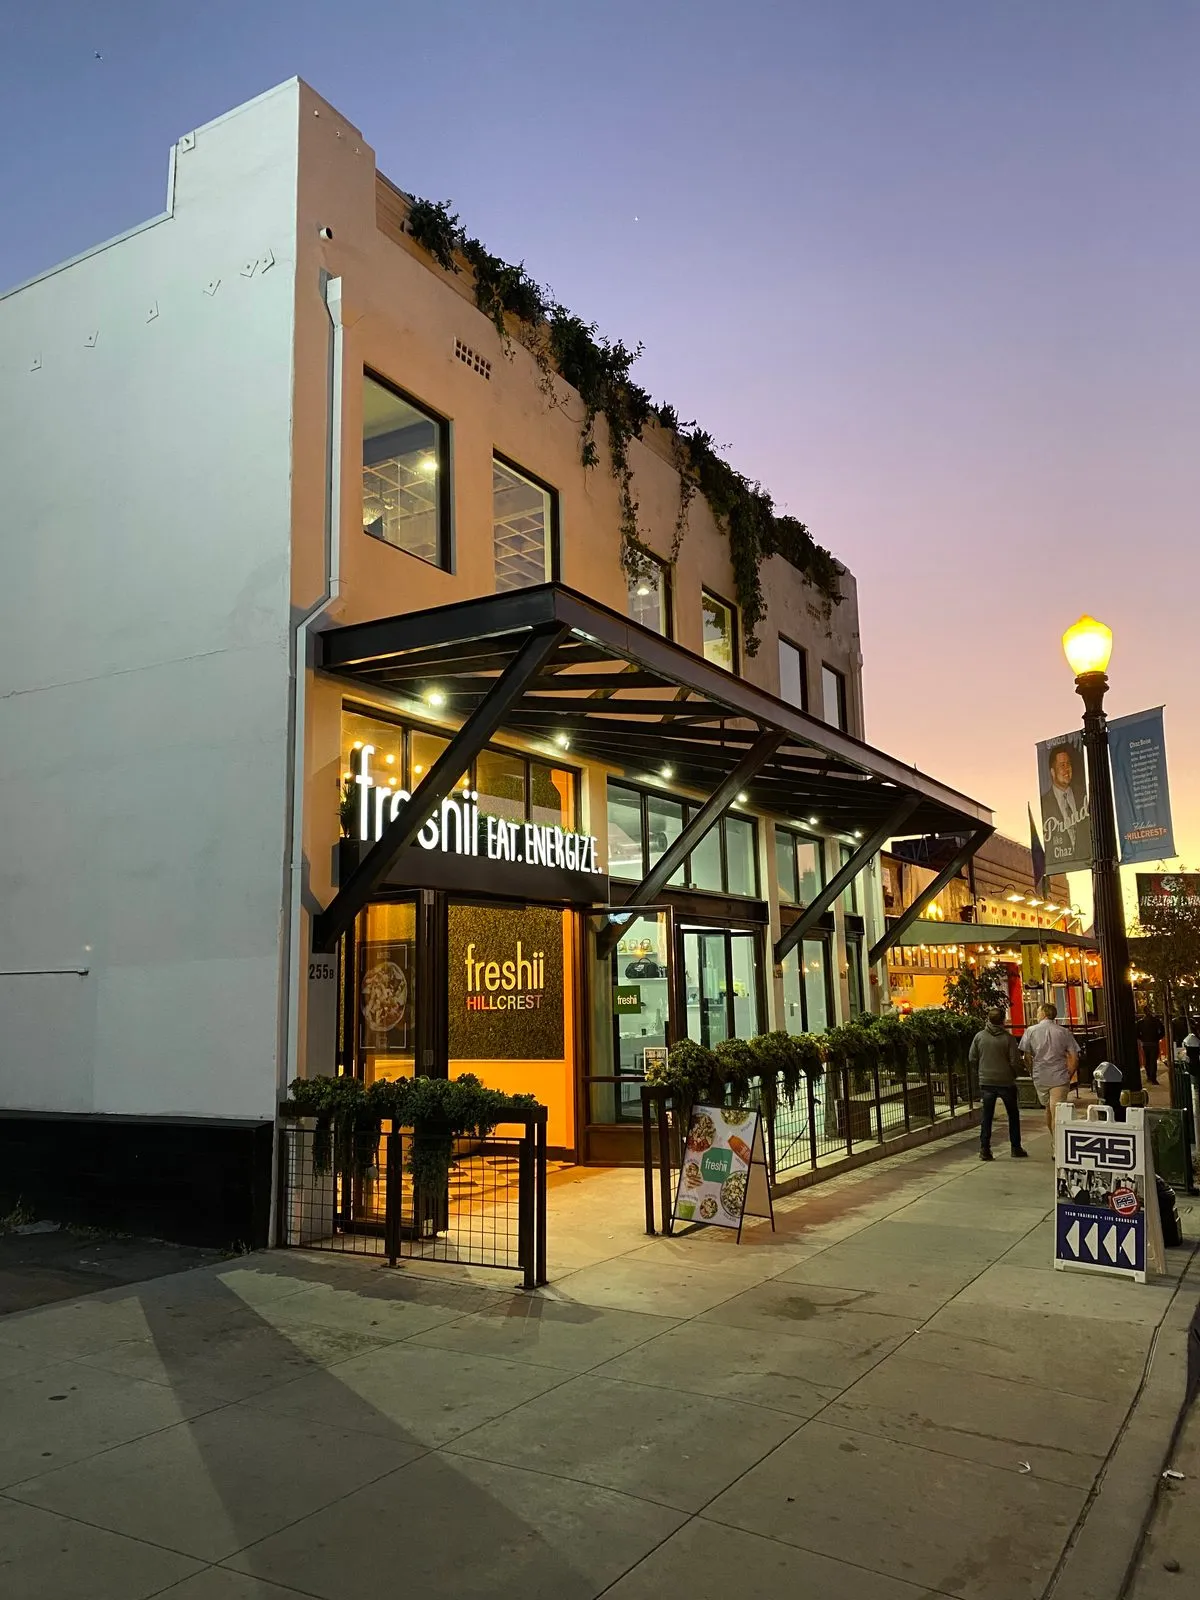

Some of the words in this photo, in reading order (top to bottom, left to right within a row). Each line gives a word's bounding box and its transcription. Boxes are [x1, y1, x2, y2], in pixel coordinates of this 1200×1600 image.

[1044, 794, 1091, 842] Proud
[1127, 827, 1164, 840] HILLCREST
[487, 815, 523, 863] EAT.
[525, 822, 602, 875] ENERGIZE.
[1054, 846, 1073, 858] Chaz
[464, 941, 545, 992] freshii
[466, 994, 544, 1011] HILLCREST
[617, 994, 638, 1005] freshii
[1065, 1130, 1136, 1171] F45
[705, 1158, 729, 1177] freshii
[1114, 1195, 1135, 1207] F45
